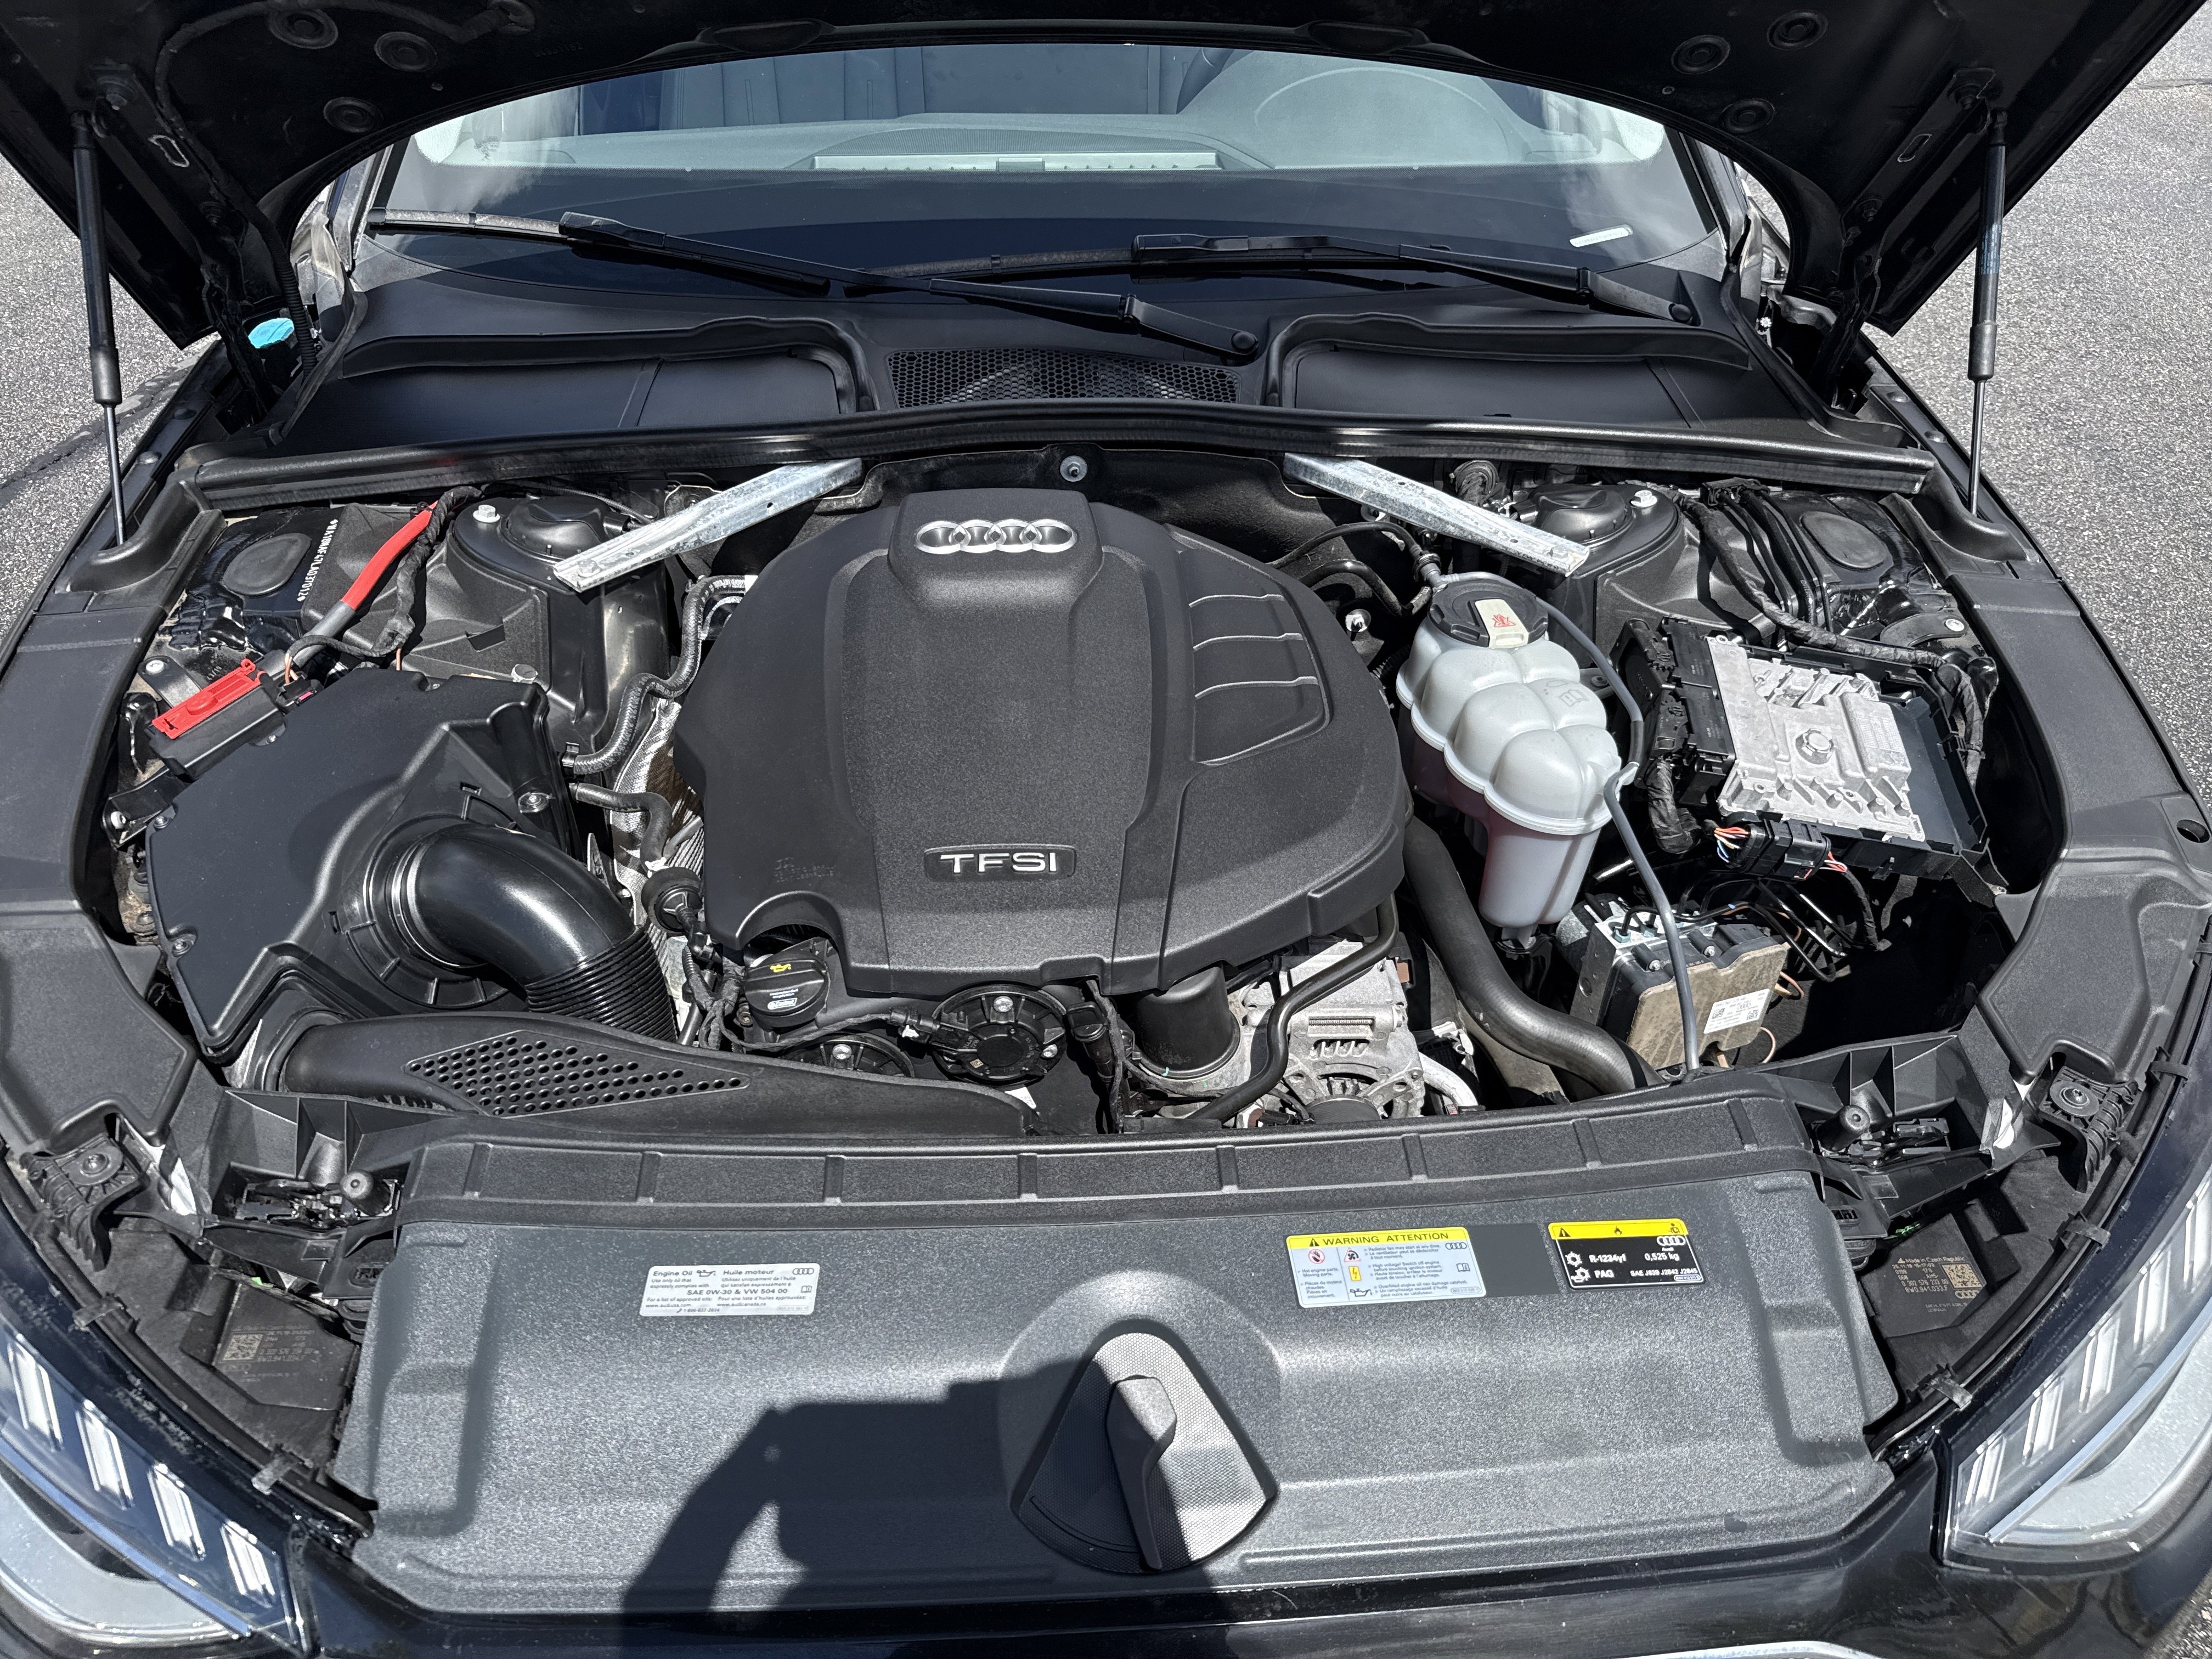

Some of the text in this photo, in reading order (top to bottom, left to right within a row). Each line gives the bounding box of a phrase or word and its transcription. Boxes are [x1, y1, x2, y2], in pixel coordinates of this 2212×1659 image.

[940, 851, 1057, 874] TFSI
[1323, 1232, 1449, 1246] WARNING ATTENTION
[1588, 1252, 1680, 1263] R-1234yf 0,525 kg
[1594, 1269, 1615, 1278] PAG
